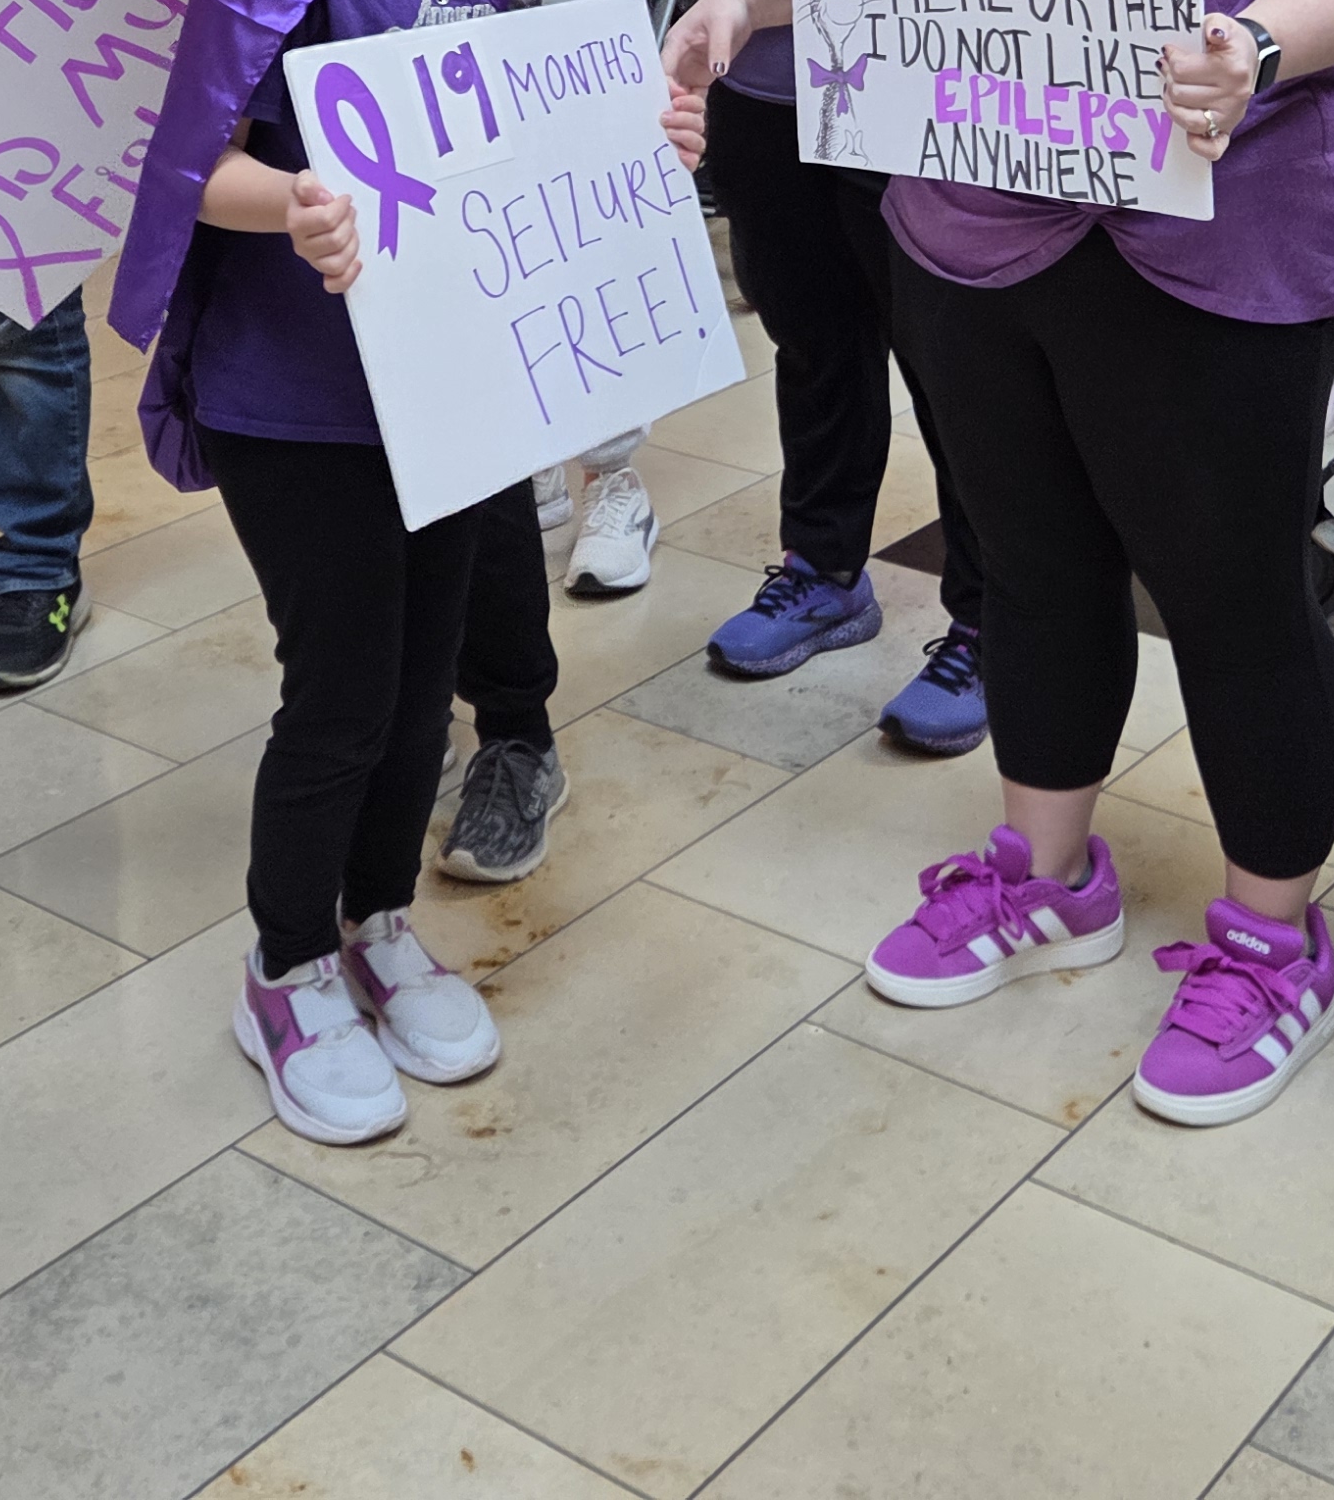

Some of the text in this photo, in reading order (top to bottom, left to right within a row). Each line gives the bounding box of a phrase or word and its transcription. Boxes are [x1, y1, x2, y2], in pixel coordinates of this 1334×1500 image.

[412, 33, 644, 157] 19 MONTHS
[864, 14, 886, 61] I
[899, 16, 945, 73] DO
[956, 28, 1031, 80] NOT
[919, 118, 1138, 207] ANYWHERE
[934, 68, 1172, 173] EPILEPSY
[462, 143, 692, 298] SEIZURE
[511, 237, 707, 425] FREE!
[1227, 928, 1271, 955] adidas
